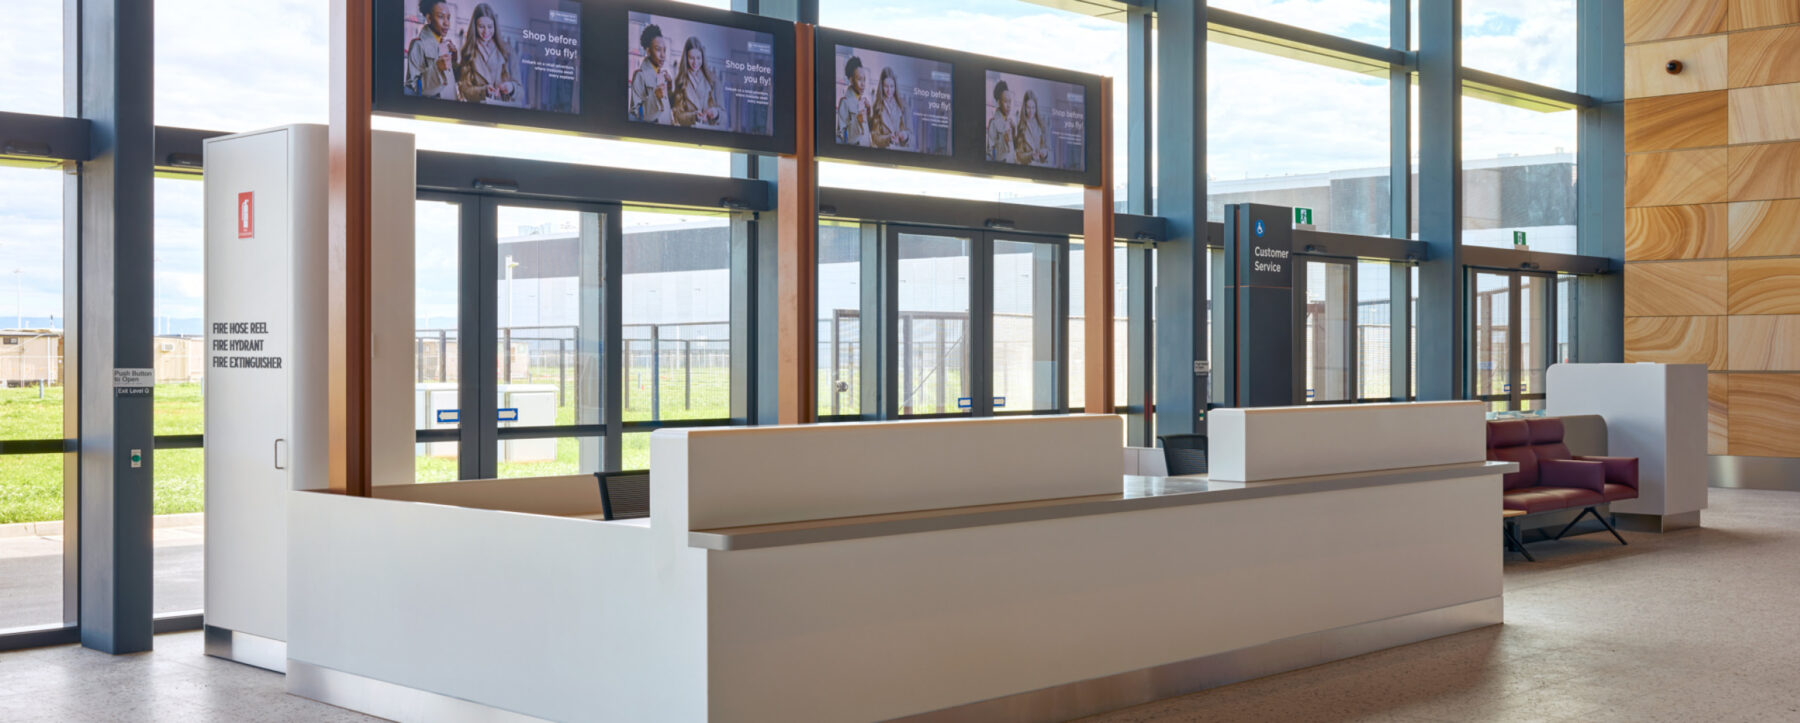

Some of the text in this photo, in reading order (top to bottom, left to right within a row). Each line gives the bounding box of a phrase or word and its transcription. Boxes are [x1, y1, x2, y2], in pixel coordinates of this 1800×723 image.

[522, 29, 578, 46] Shop before
[544, 47, 577, 59] you fly!
[725, 60, 771, 74] Shop before
[744, 75, 771, 86] you fly!
[913, 88, 951, 100] Shop before
[928, 101, 951, 111] you fly!
[1051, 107, 1084, 119] Shop before
[1254, 246, 1289, 259] Customer
[1254, 261, 1281, 272] Service
[213, 322, 269, 334] FIRE HOSE REEL
[213, 339, 264, 351] FIRE HYDRANT
[213, 356, 282, 369] FIRE EXTINGUISHER
